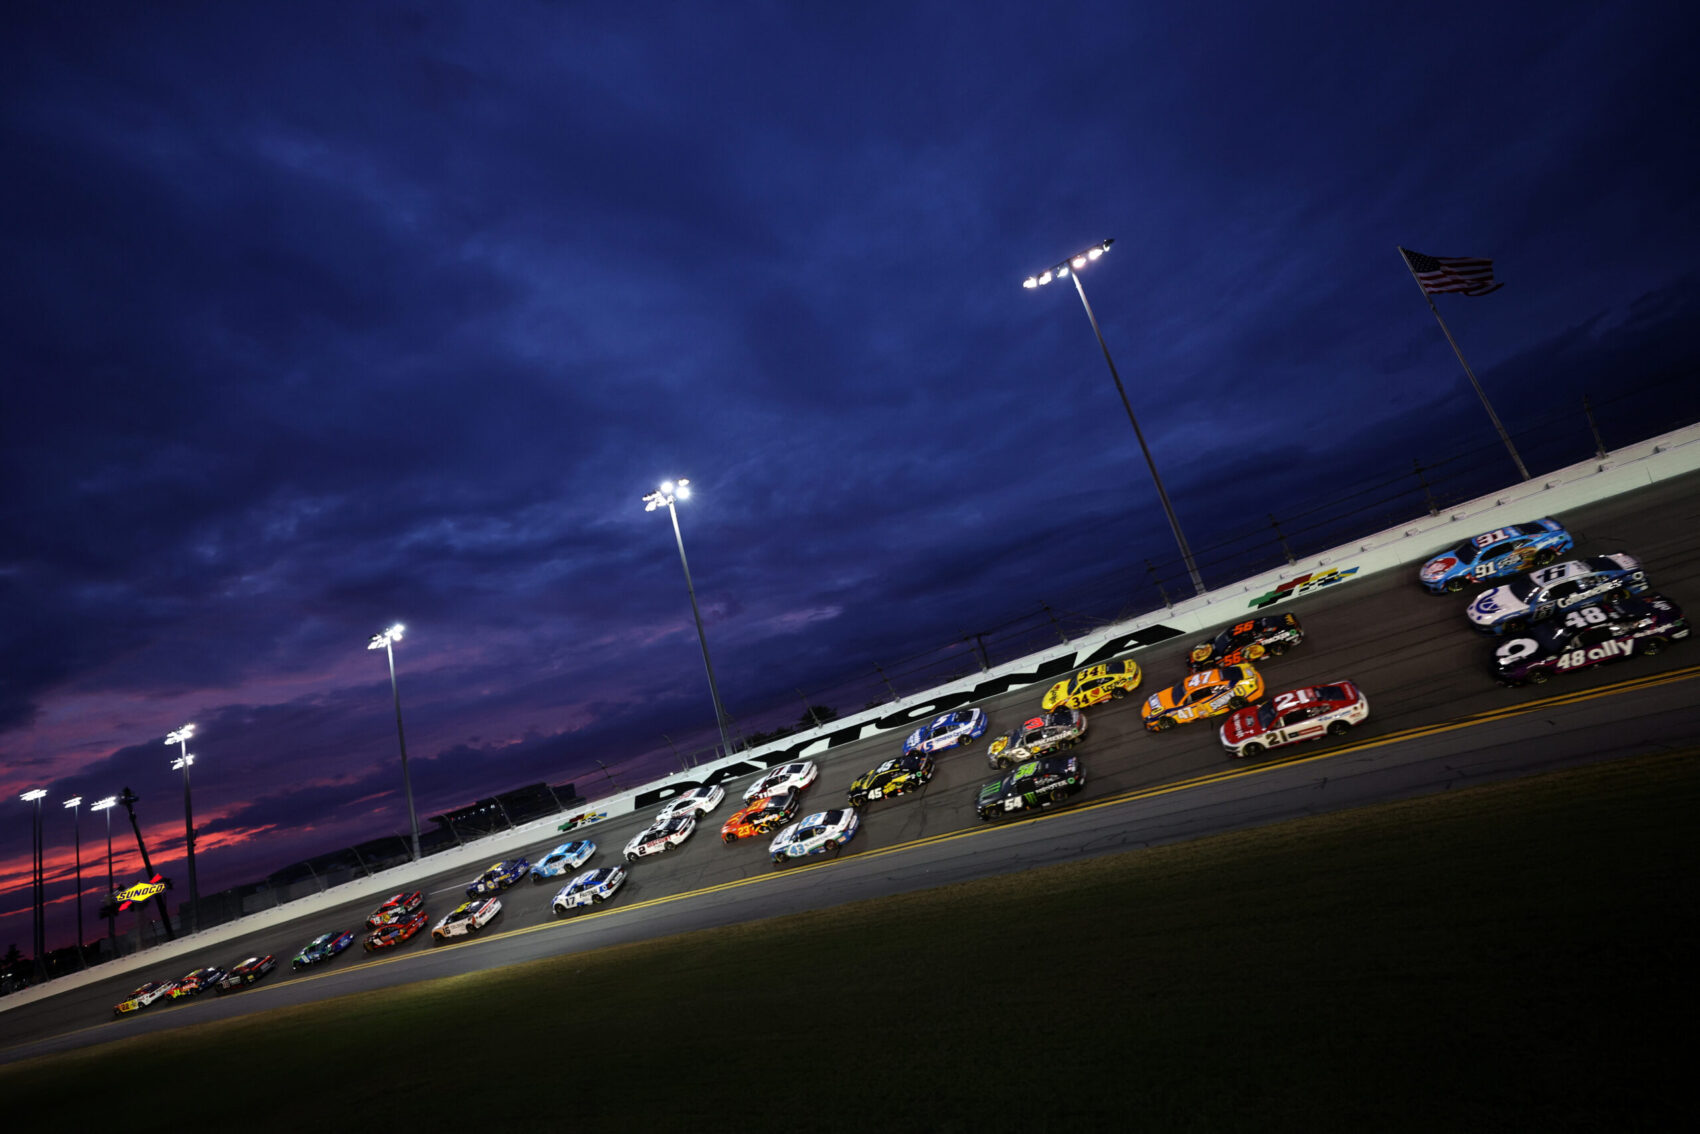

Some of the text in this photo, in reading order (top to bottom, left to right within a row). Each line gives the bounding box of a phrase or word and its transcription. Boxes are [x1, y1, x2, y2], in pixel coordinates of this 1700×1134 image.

[1476, 530, 1509, 548] 91
[1475, 562, 1497, 578] 91
[1564, 606, 1607, 628] 48
[1231, 620, 1255, 636] 56
[1222, 651, 1241, 667] 56
[1556, 639, 1633, 669] 48 ally
[1079, 667, 1098, 681] 34
[1188, 671, 1212, 687] 47
[1072, 694, 1089, 707] 34
[1274, 690, 1310, 711] 21
[635, 624, 1187, 811] DAYTONA
[1177, 707, 1194, 719] 47
[931, 713, 953, 729] 5
[1024, 717, 1045, 729] 3
[1266, 731, 1288, 746] 21
[925, 742, 938, 751] 5
[1011, 747, 1031, 758] 3
[868, 787, 883, 800] 45
[1003, 795, 1023, 812] 54
[738, 825, 751, 837] 23
[638, 846, 646, 855] 2
[789, 844, 805, 855] 43
[119, 885, 164, 901] SUNOCO
[565, 896, 576, 906] 17
